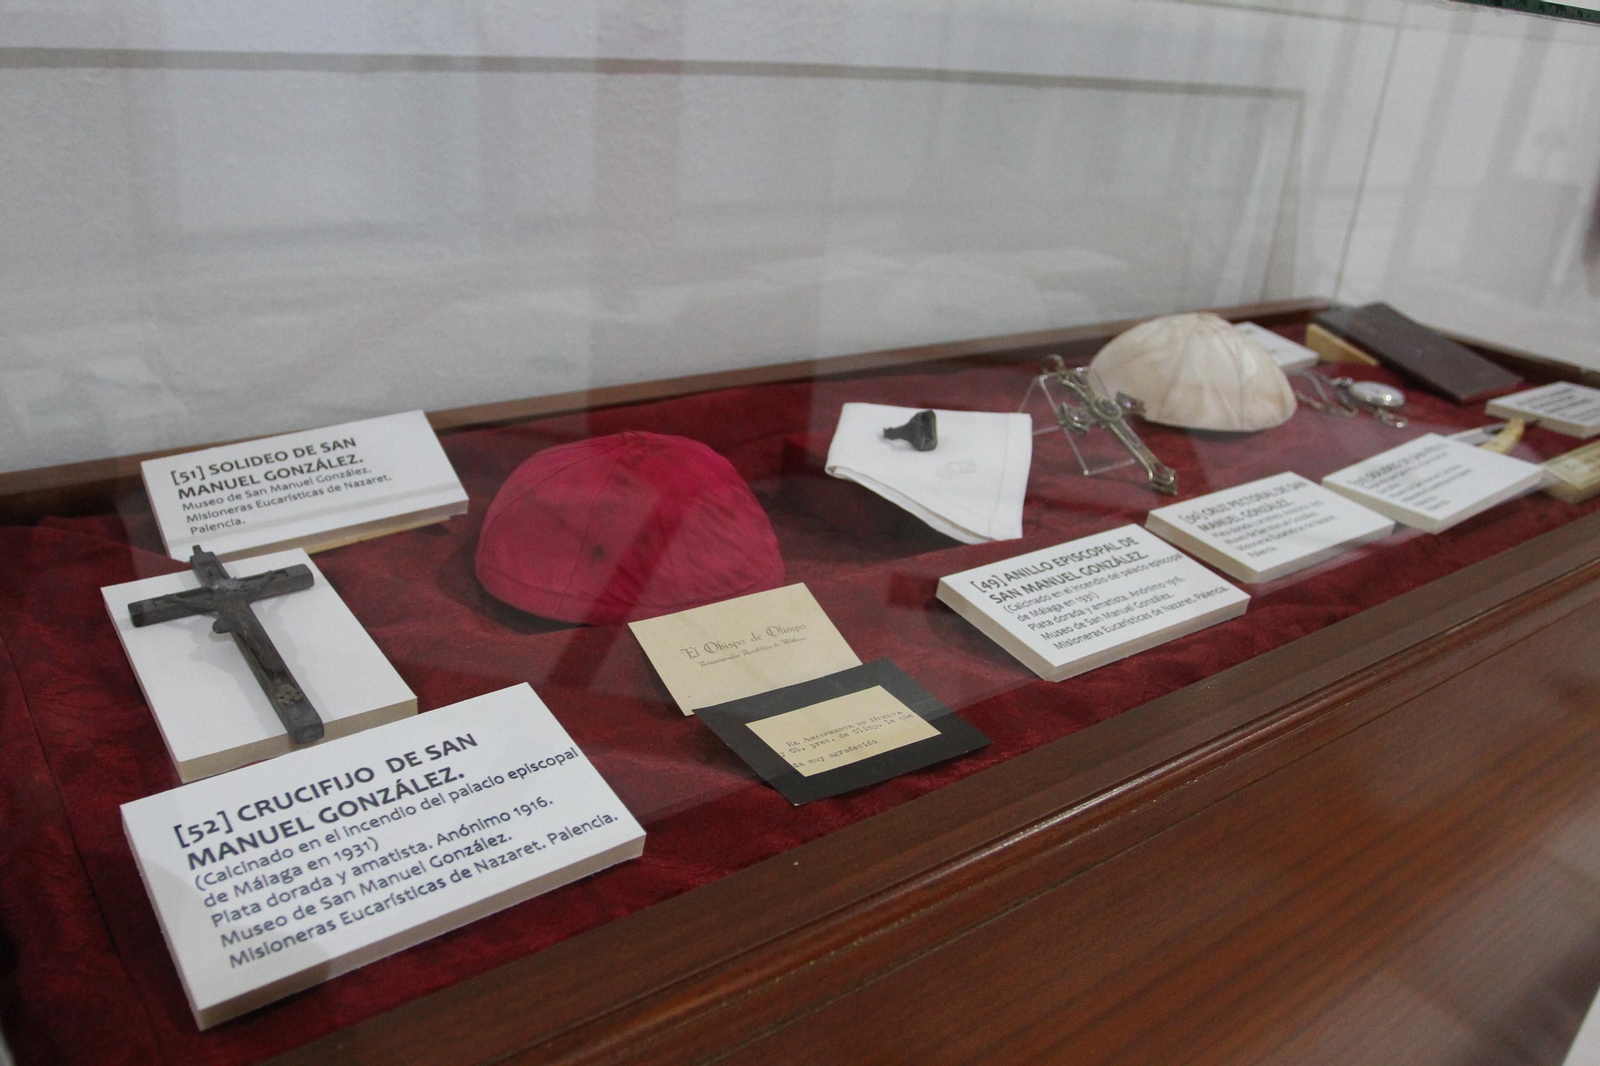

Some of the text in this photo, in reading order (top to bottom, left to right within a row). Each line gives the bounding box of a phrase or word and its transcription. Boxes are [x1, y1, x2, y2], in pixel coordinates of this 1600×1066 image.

[170, 438, 356, 486] [51] SOLIDEO DE SAN
[178, 454, 363, 499] MANUEL GONZÁLEZ.
[182, 467, 371, 511] Museo de San Manuel González.
[186, 475, 391, 523] Misioneras Eucarísticas de Nazaret.
[190, 518, 245, 535] Palencia.
[970, 537, 1139, 593] [49] ANILLO EPISCOPAL DE
[989, 551, 1149, 604] SAN MANUEL GONZÁLEZ.
[1003, 595, 1052, 614] (Calcinado
[1070, 577, 1108, 591] incendio
[1107, 572, 1121, 580] del
[1017, 614, 1031, 622] de
[1029, 603, 1064, 617] Málaga
[1075, 591, 1100, 603] 1931)
[1027, 620, 1054, 631] Plata
[1053, 609, 1086, 623] dorada
[1091, 595, 1130, 610] amatista.
[1128, 583, 1166, 598] Anónimo
[1040, 593, 1174, 640] Museo de San Manuel González.
[680, 646, 700, 659] El
[703, 639, 745, 654] Obispo
[765, 624, 806, 637] Olimpo
[1053, 630, 1104, 650] Misioneras
[1101, 613, 1152, 633] Eucarísticas
[1161, 597, 1197, 611] Nazaret.
[1193, 586, 1229, 599] Palencia.
[829, 740, 878, 758] agradecido
[173, 733, 478, 849] [52] CRUCIFIJO DE SAN
[187, 766, 464, 870] MANUEL GONZÁLEZ.
[195, 747, 579, 892] (Calcinado en el incendio del palacio episcopal
[204, 836, 379, 908] de Málaga en 1931)
[210, 796, 553, 928] Plata dorada y amatista. Anónimo 1916.
[220, 834, 512, 948] Museo de San Manuel González.
[229, 814, 618, 969] Misioneras Eucarísticas de Nazaret. Palencia.
